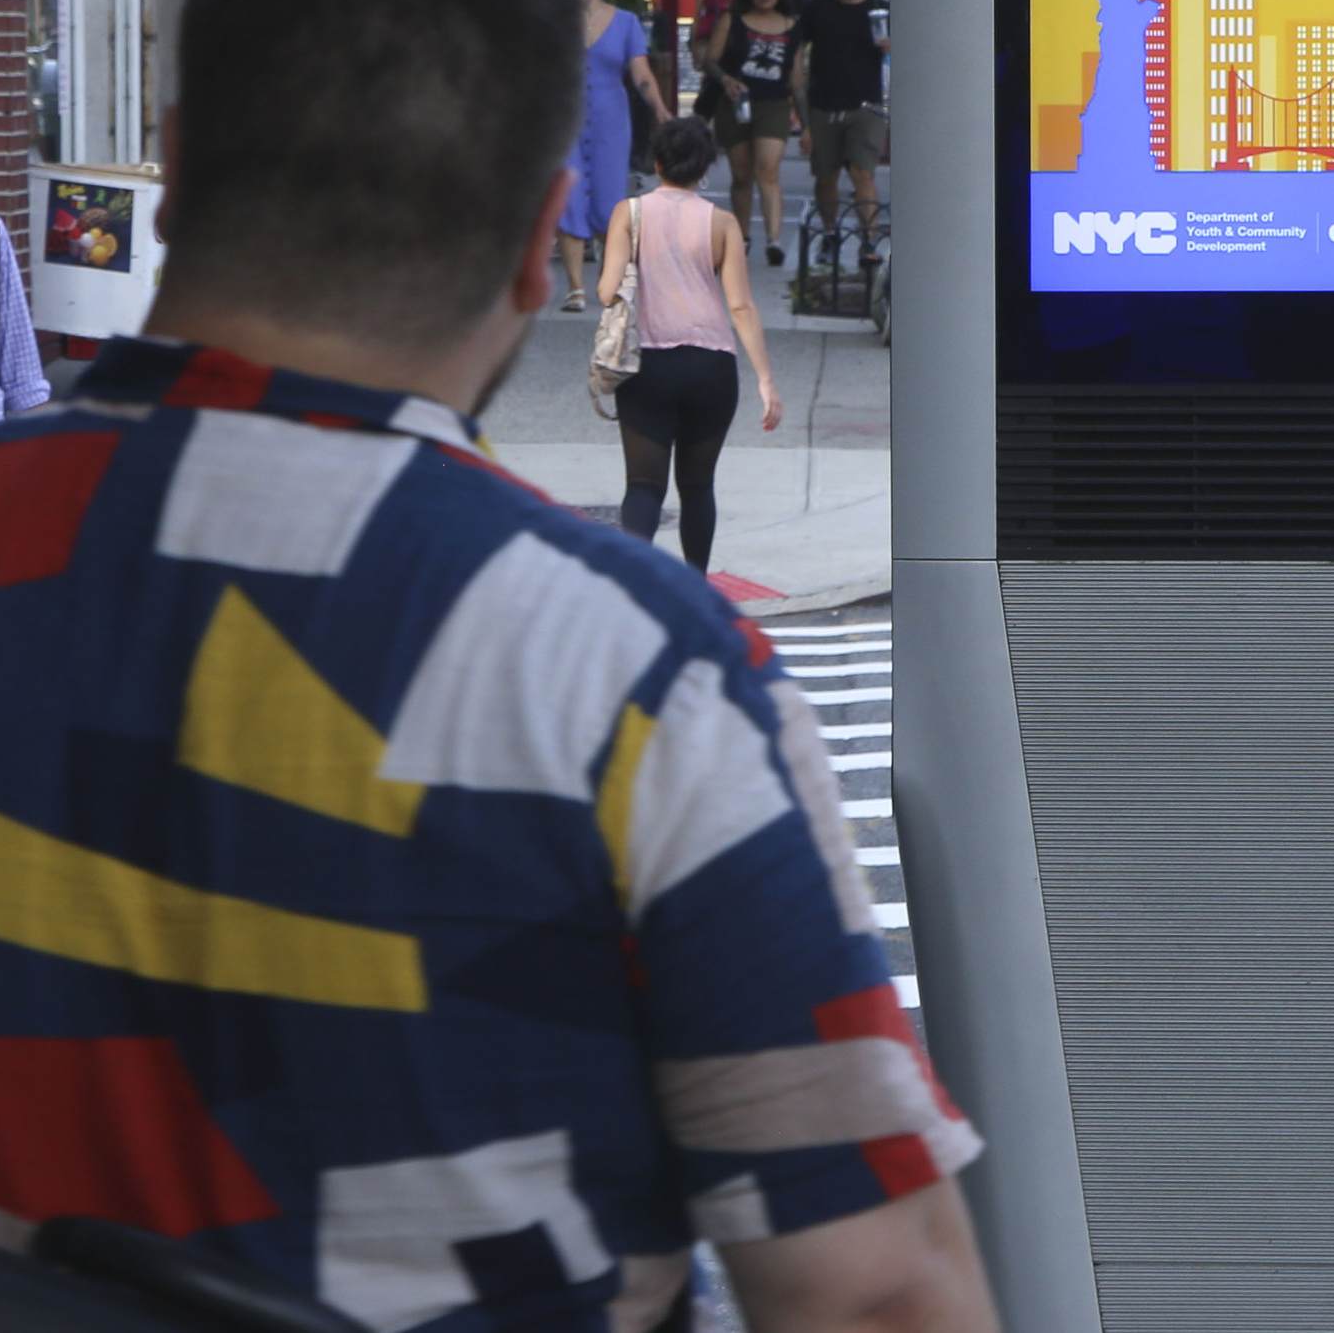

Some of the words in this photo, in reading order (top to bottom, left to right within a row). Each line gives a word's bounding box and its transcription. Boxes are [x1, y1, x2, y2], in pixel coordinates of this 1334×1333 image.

[1187, 211, 1259, 224] Department
[1261, 211, 1275, 222] of
[1053, 211, 1177, 254] NYC
[1186, 226, 1223, 237] Youth
[1225, 226, 1235, 237] &
[1237, 226, 1306, 240] Community
[1187, 241, 1267, 253] Development
